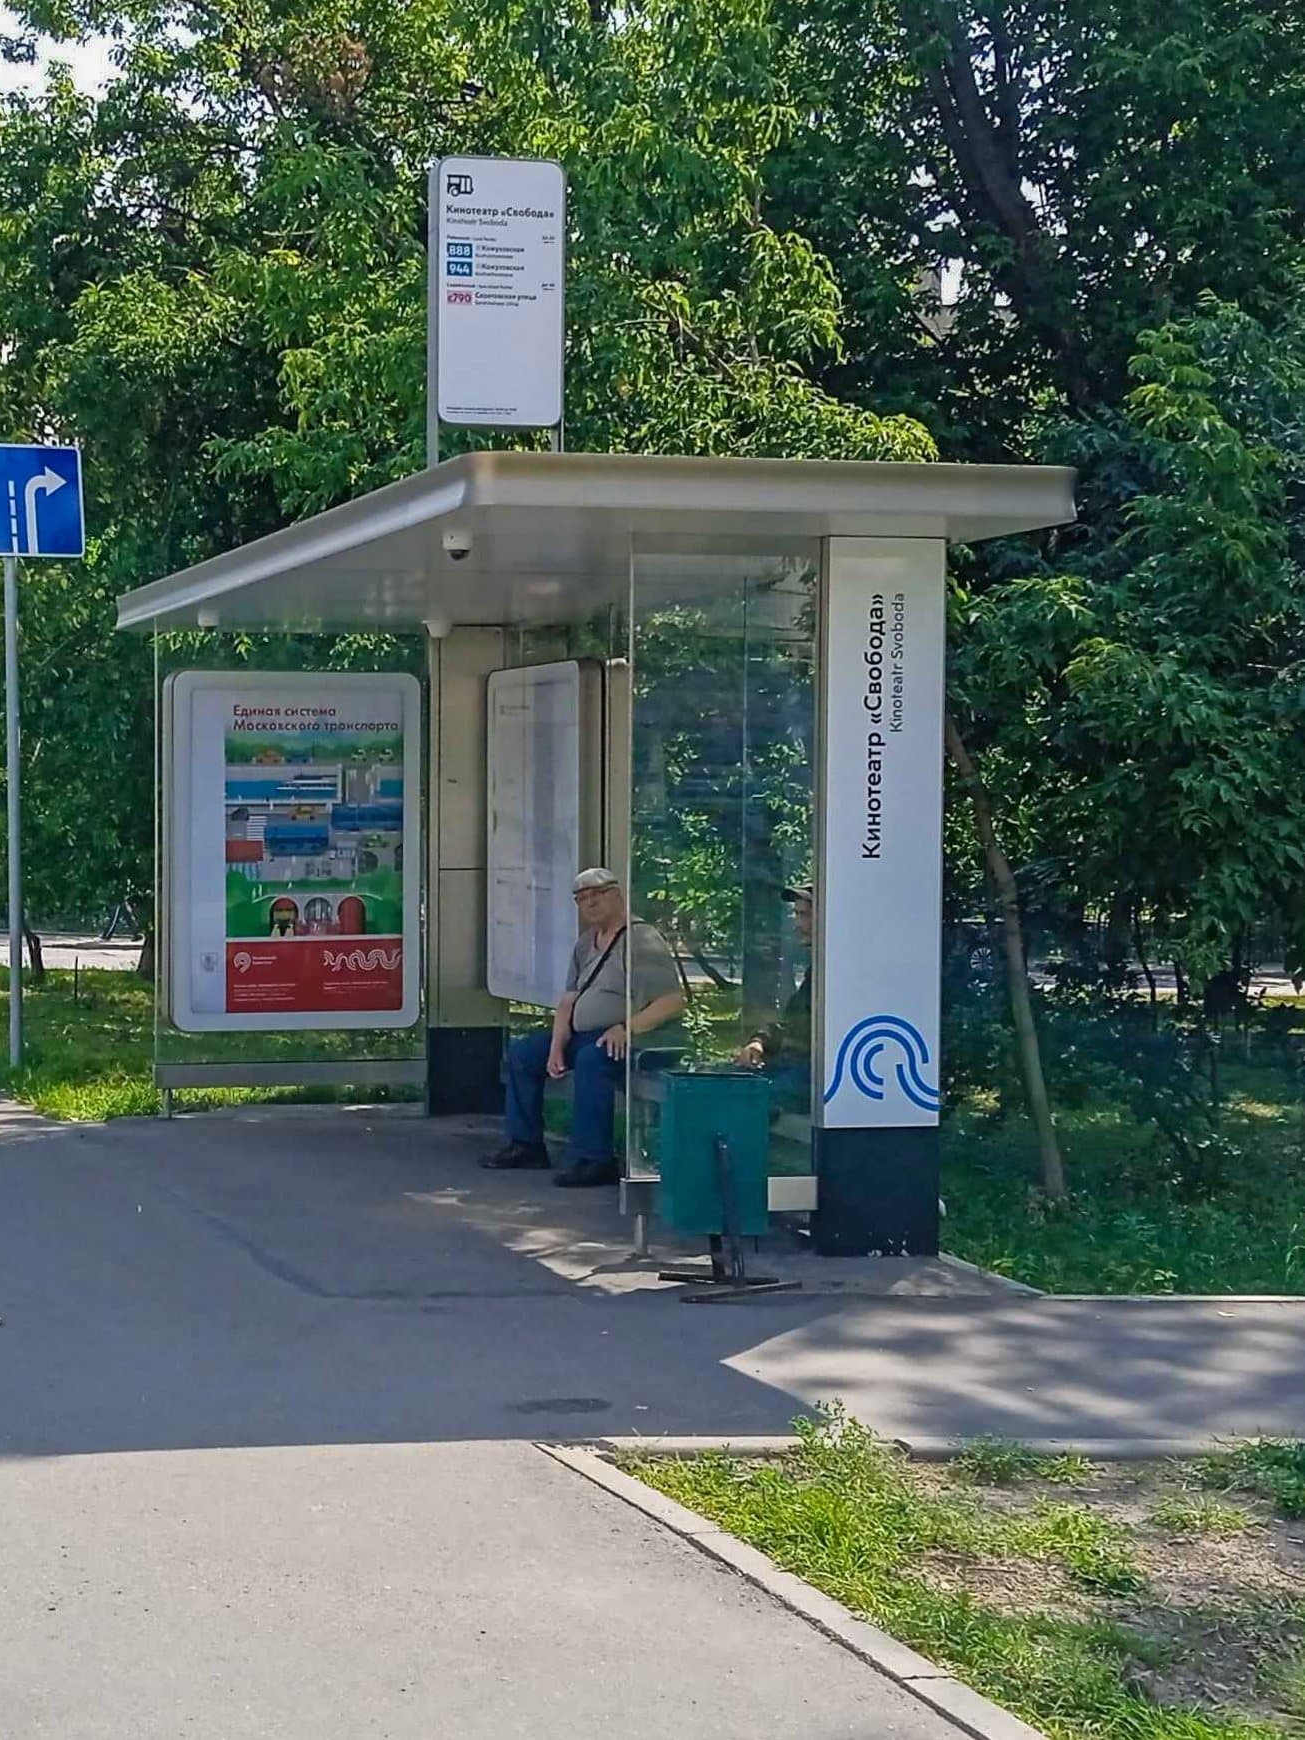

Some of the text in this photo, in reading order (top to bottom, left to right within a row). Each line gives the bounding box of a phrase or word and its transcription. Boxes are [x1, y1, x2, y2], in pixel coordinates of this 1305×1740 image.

[446, 204, 555, 219] Кинотеатр «Свобода»
[449, 244, 471, 256] 888
[449, 263, 470, 274] 944
[889, 592, 905, 732] Kinoteatr Svoboda
[233, 704, 336, 718] Единая система
[233, 719, 399, 732] Московского транспорта
[861, 593, 886, 859] Кинотеатр «Свобода»
